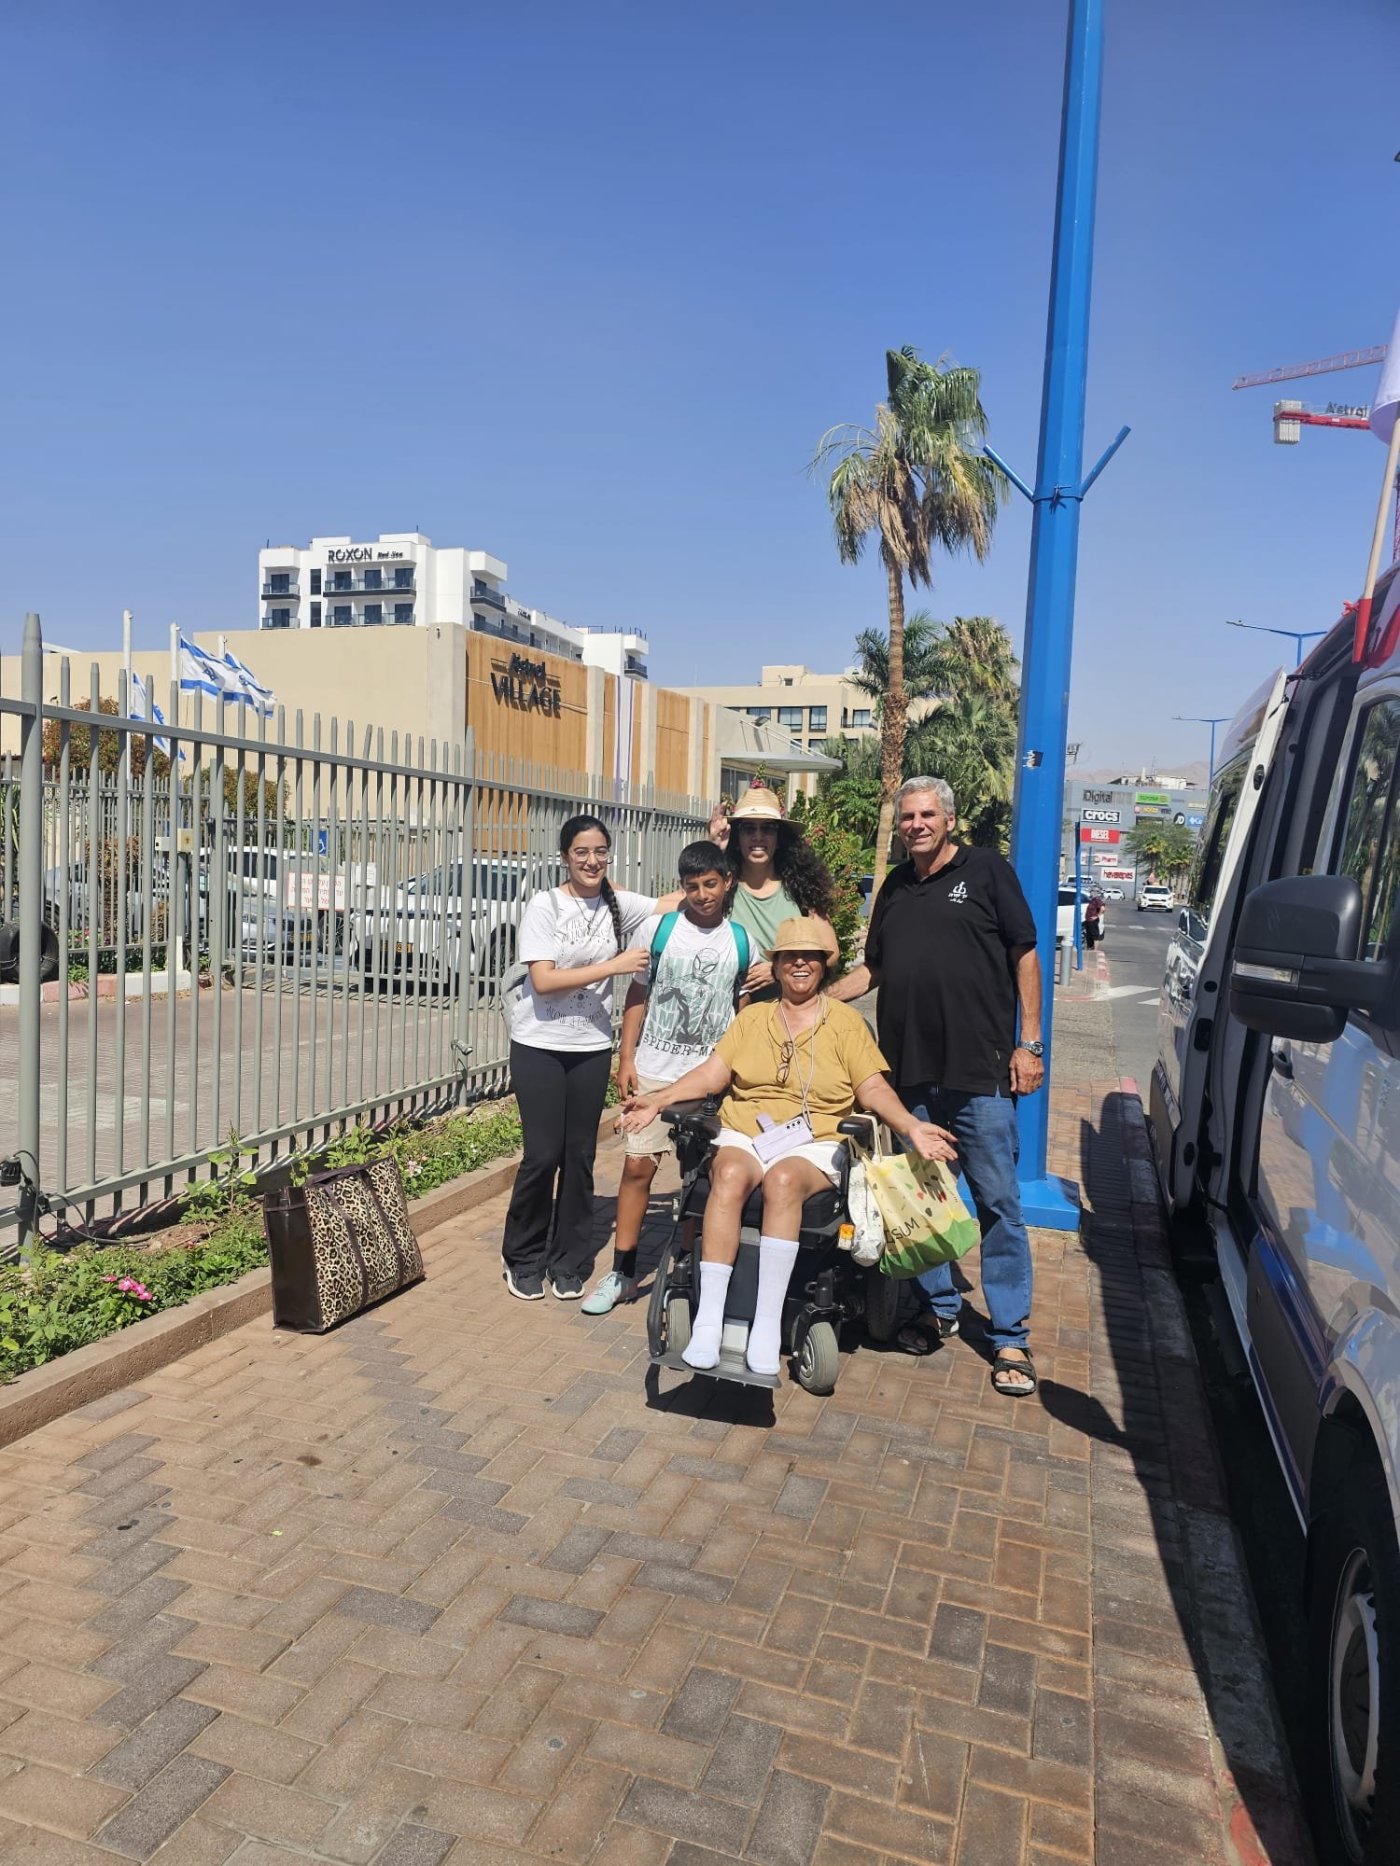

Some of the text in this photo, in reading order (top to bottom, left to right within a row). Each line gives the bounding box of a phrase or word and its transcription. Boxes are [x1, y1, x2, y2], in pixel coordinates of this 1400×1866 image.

[327, 547, 373, 563] ROXON
[490, 672, 562, 713] VILLAGE
[1085, 810, 1118, 822] crocs
[1175, 815, 1185, 825] JD
[643, 1033, 713, 1057] SPIDER-M
